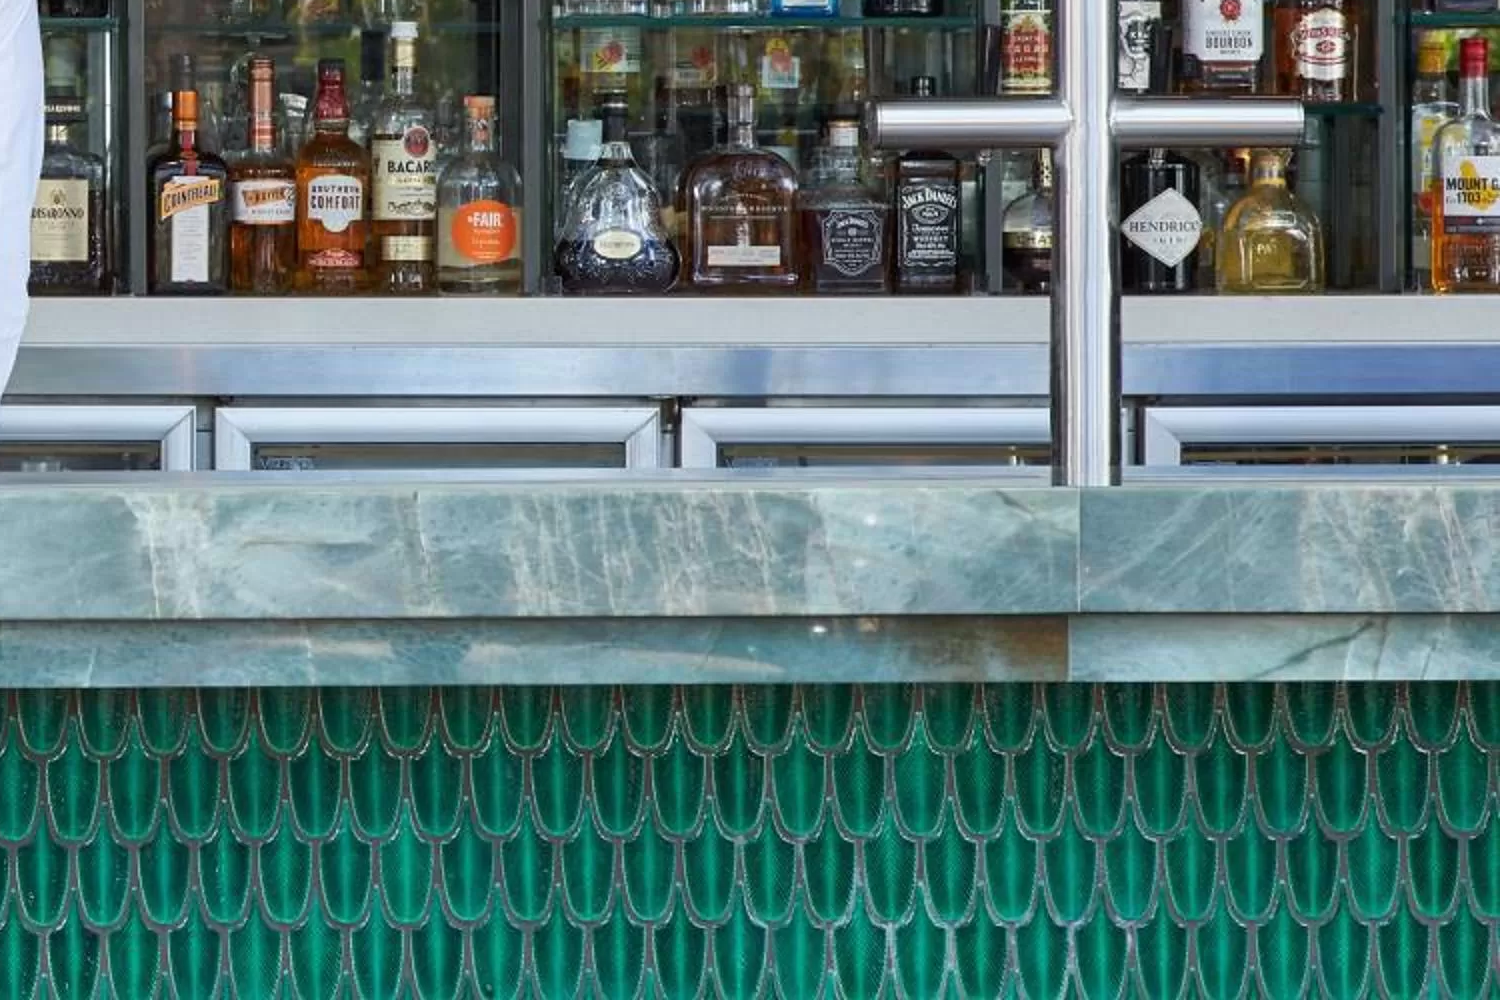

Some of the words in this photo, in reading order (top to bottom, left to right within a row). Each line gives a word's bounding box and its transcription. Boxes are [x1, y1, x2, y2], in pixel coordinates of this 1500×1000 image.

[1205, 36, 1253, 50] BOURBON
[387, 160, 437, 174] BACAR
[311, 185, 360, 194] SOUTHERN
[1446, 177, 1488, 191] MOUNT
[163, 184, 218, 215] COINTREAU
[310, 195, 361, 211] COMFORT
[1457, 190, 1481, 205] 1703
[31, 206, 85, 220] DISARONNO
[473, 211, 503, 227] FAIR
